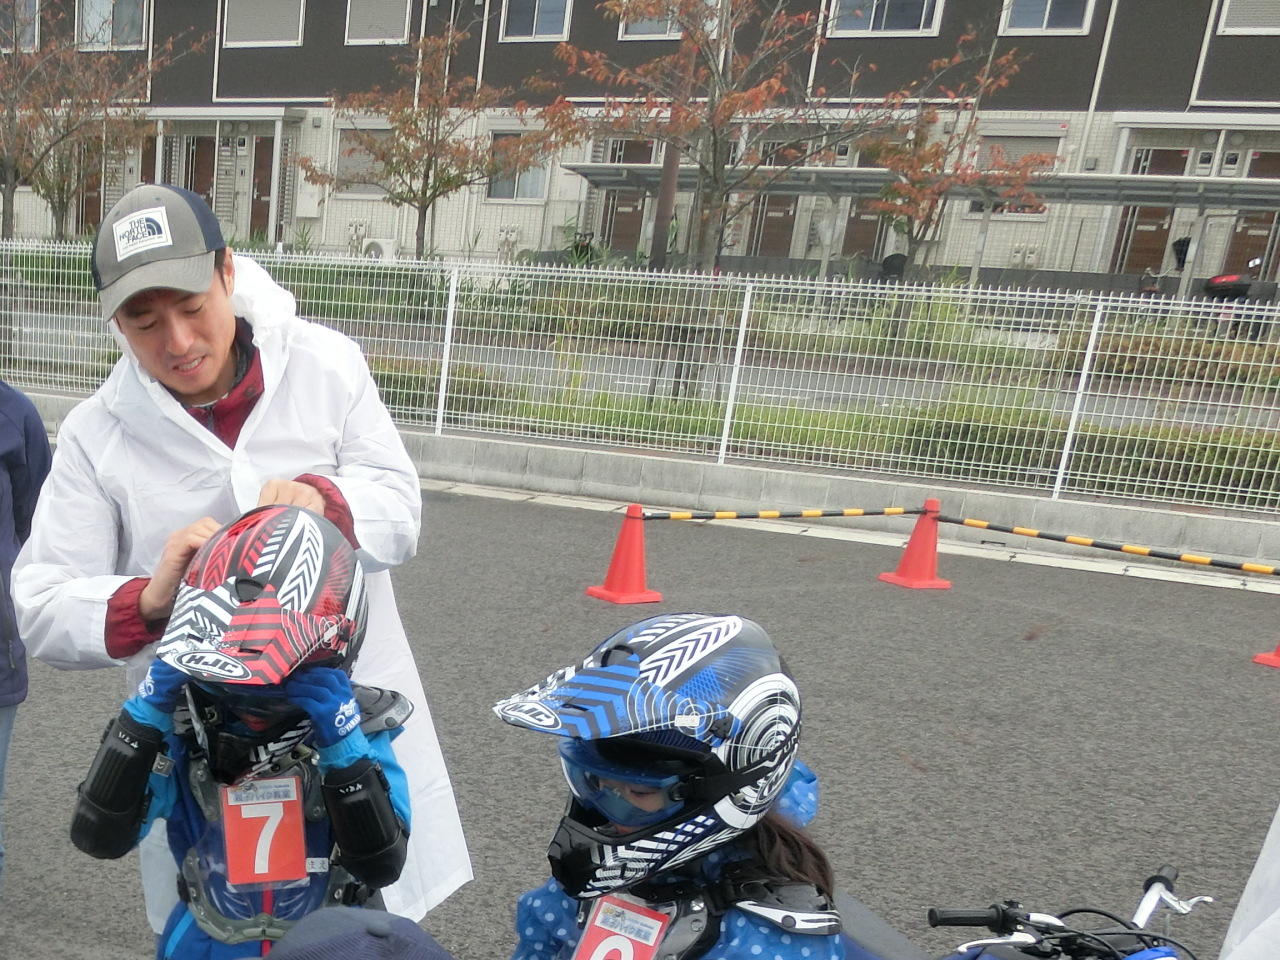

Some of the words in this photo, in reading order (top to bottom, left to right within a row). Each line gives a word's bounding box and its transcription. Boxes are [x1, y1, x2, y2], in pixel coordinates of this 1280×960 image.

[186, 655, 238, 673] HJC
[507, 704, 552, 722] HJC
[241, 802, 284, 874] 7
